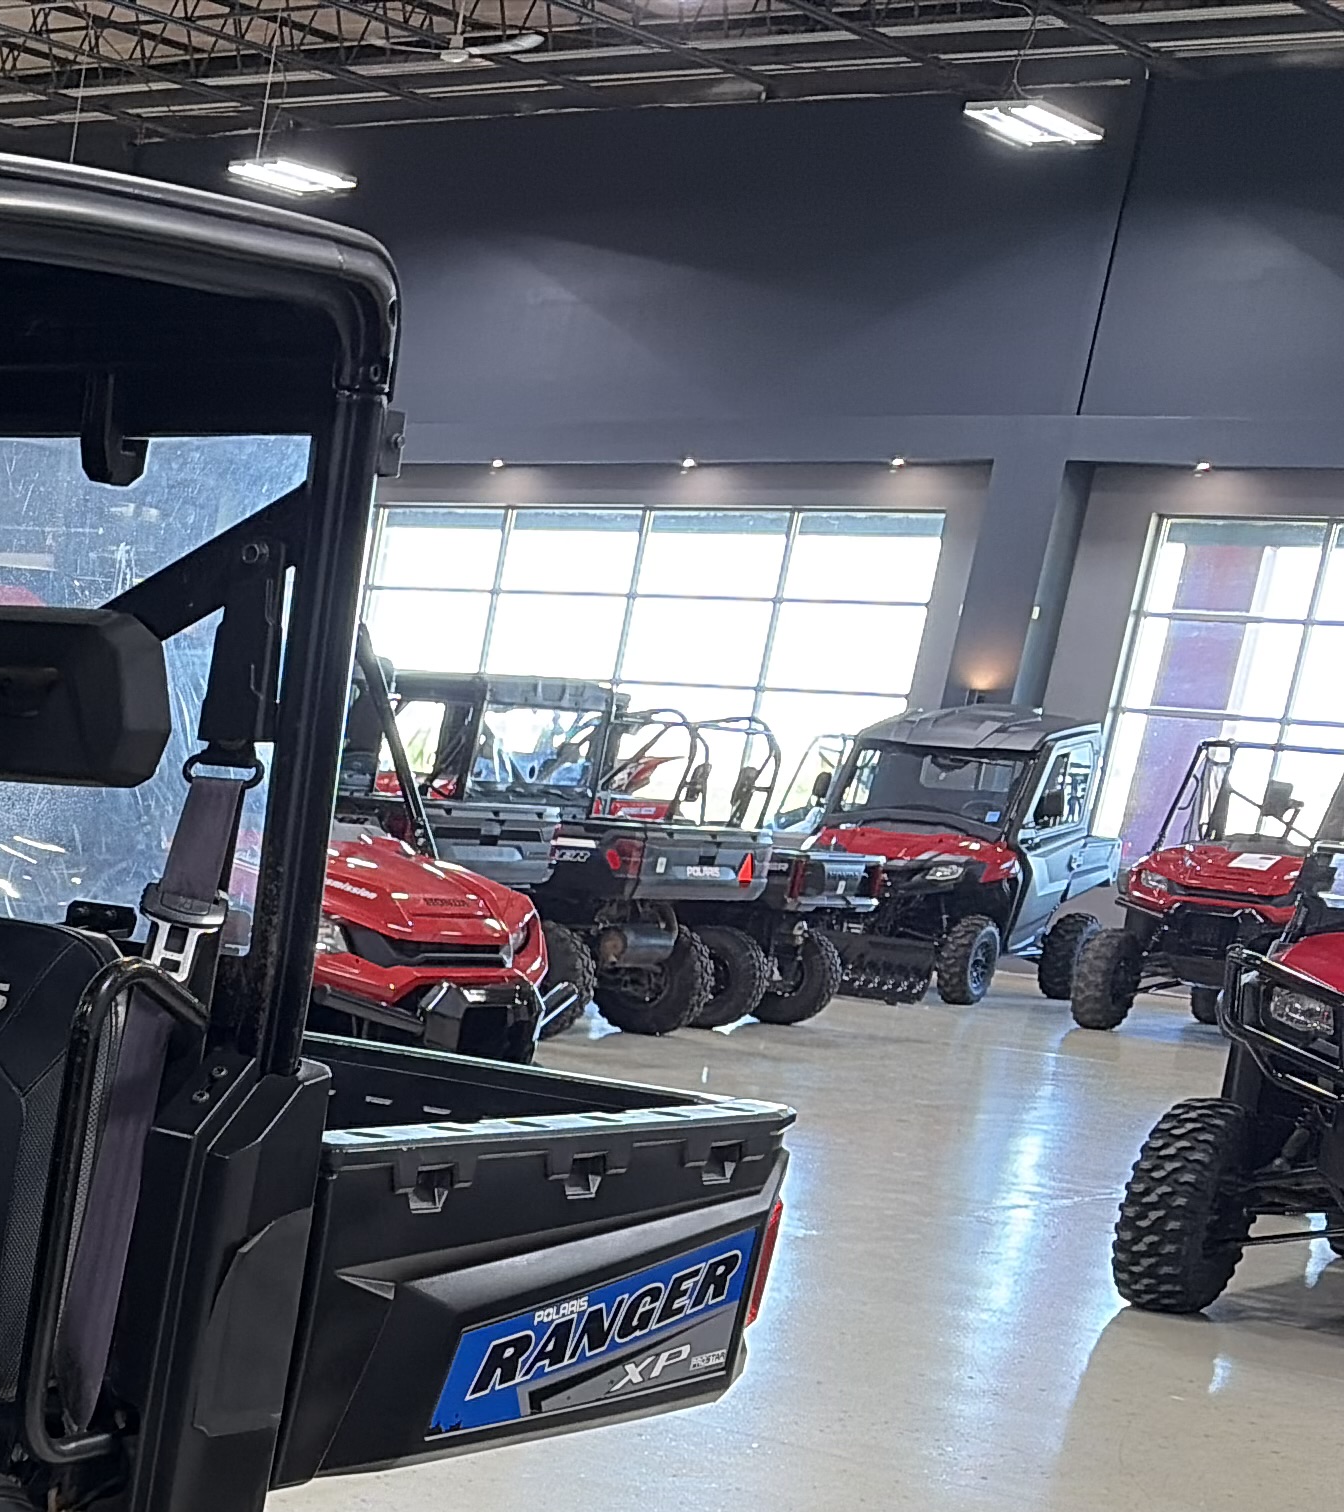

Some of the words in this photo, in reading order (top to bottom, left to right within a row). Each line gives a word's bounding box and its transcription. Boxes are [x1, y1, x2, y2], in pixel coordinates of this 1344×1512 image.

[686, 865, 720, 878] POLARIS
[464, 1250, 742, 1402] RANGER
[534, 1296, 589, 1326] POLARIS
[609, 1344, 691, 1393] XP
